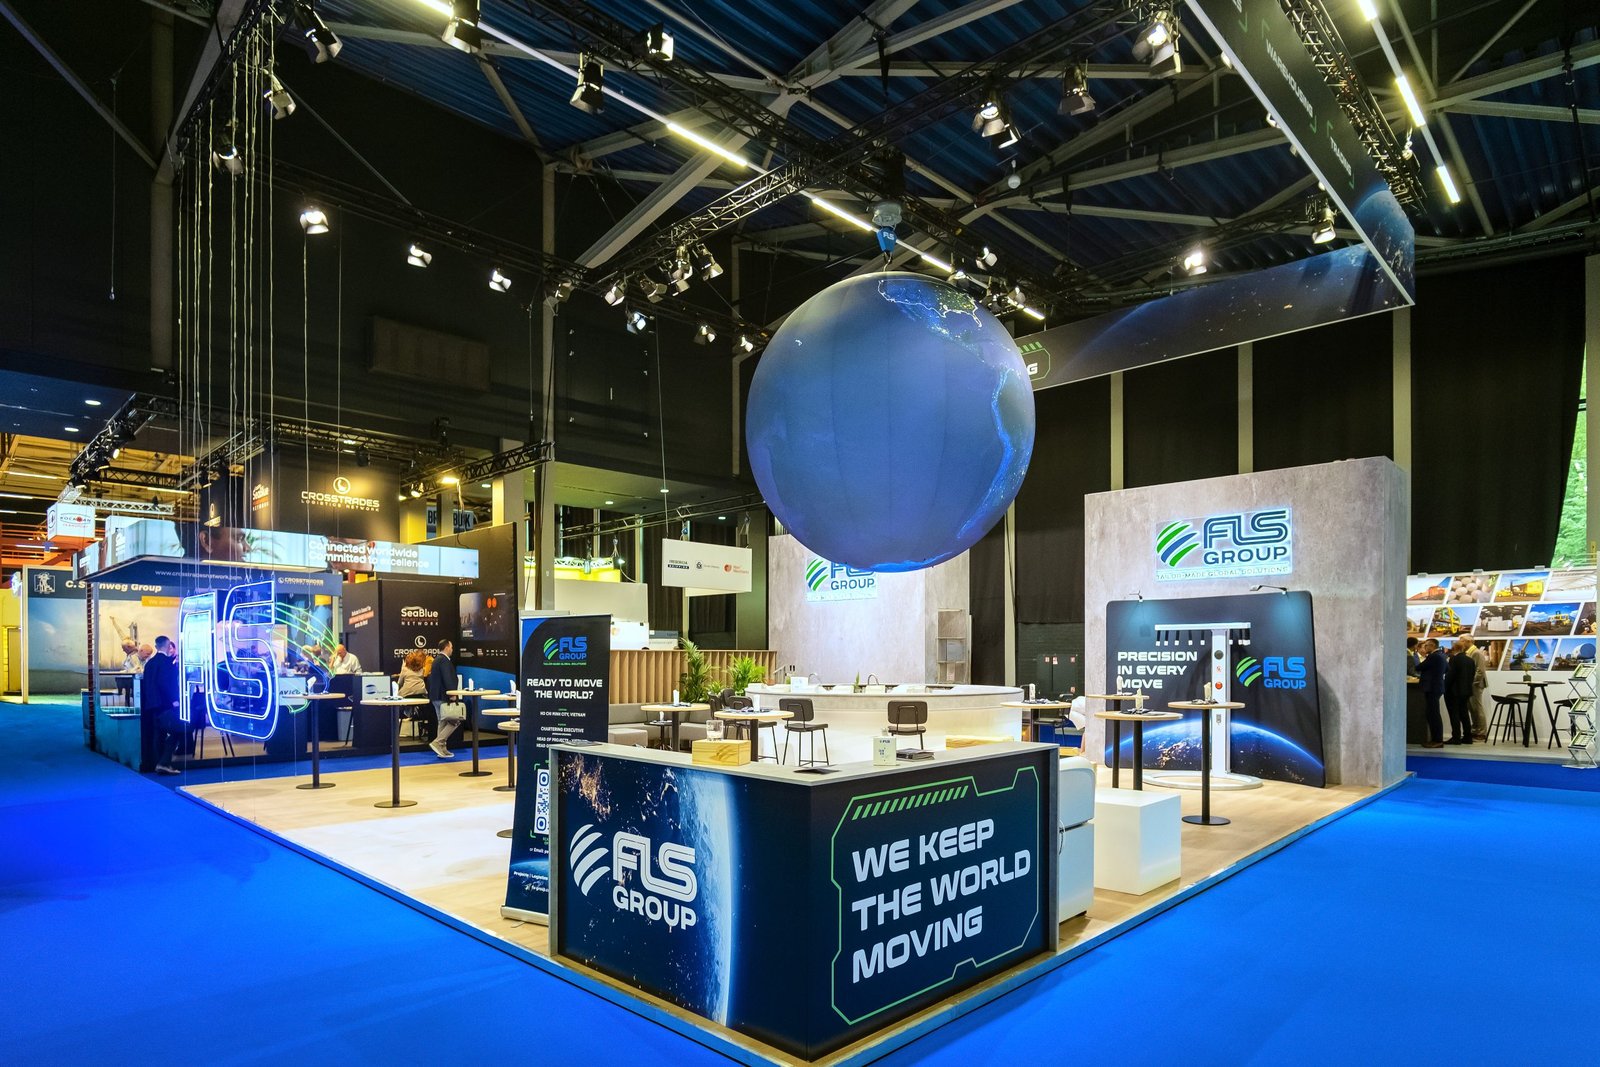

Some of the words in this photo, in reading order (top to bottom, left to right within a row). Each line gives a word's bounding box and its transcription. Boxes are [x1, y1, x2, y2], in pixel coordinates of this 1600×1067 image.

[301, 491, 380, 508] CROSSTRADES
[1203, 510, 1288, 549] FLS
[309, 540, 365, 554] Connected
[309, 550, 366, 564] Committed
[1203, 546, 1288, 565] GROUP
[65, 580, 77, 588] C.
[130, 583, 162, 593] Group
[830, 578, 875, 591] GROUP
[401, 608, 439, 618] SeaBlue
[560, 636, 587, 653] FLS
[560, 652, 587, 660] GROUP
[1117, 651, 1198, 662] PRECISION
[1117, 665, 1133, 675] IN
[1136, 665, 1187, 675] EVERY
[1263, 656, 1307, 679] FLS
[526, 678, 557, 687] READY
[559, 679, 572, 687] TO
[573, 679, 603, 688] MOVE
[1121, 679, 1163, 689] MOVE
[1263, 678, 1307, 689] GROUP
[534, 690, 553, 699] THE
[554, 690, 594, 699] WORLD?
[852, 838, 910, 883] WE
[919, 818, 994, 866] KEEP
[613, 831, 698, 903] FLS
[851, 882, 922, 932] THE
[930, 849, 1031, 906] WORLD
[613, 885, 697, 930] GROUP
[852, 905, 983, 984] MOVING
